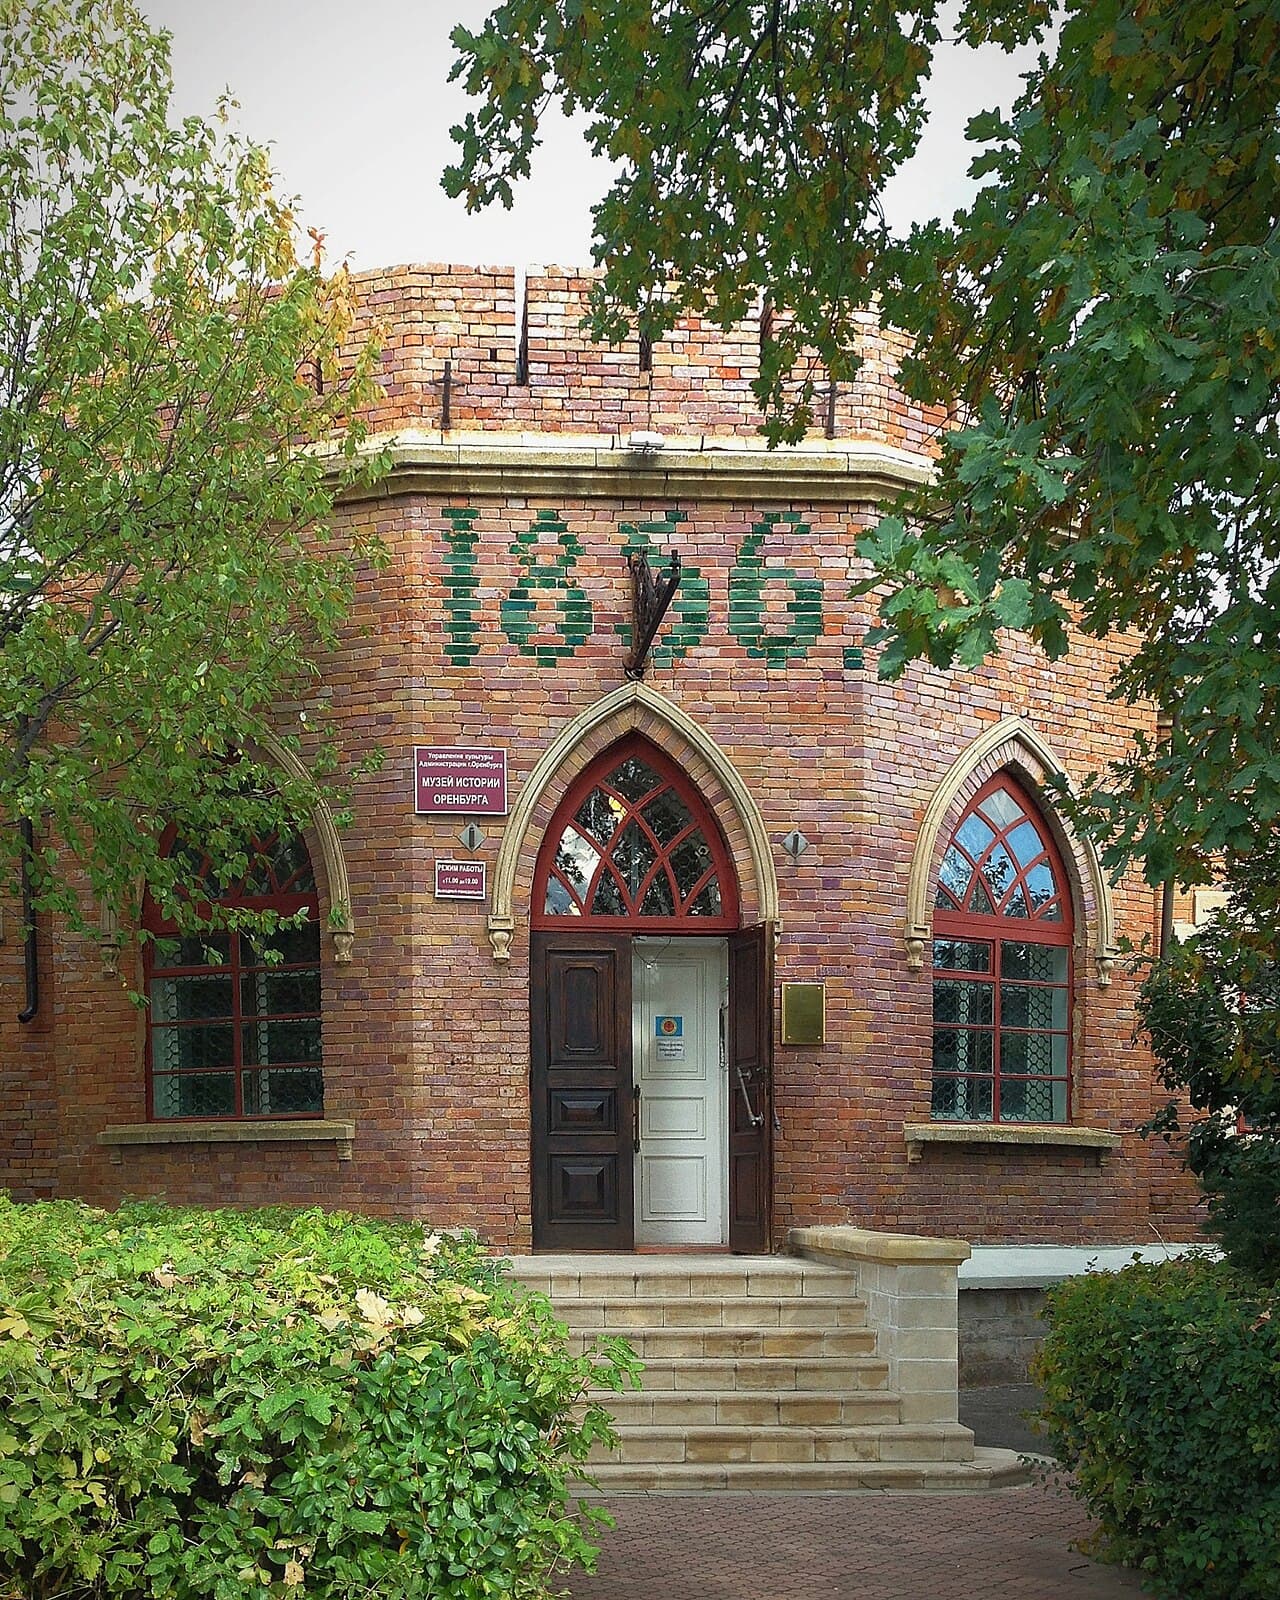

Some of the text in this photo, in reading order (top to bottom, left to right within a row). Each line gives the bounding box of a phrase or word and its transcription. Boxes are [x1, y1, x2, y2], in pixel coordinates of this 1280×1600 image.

[465, 753, 493, 761] культуры
[422, 775, 500, 788] МУЗЕЙ ИСТОРИИ
[433, 794, 489, 805] ОРЕНБУРГА
[438, 864, 483, 873] РЕЖИМ РАБОТЫ
